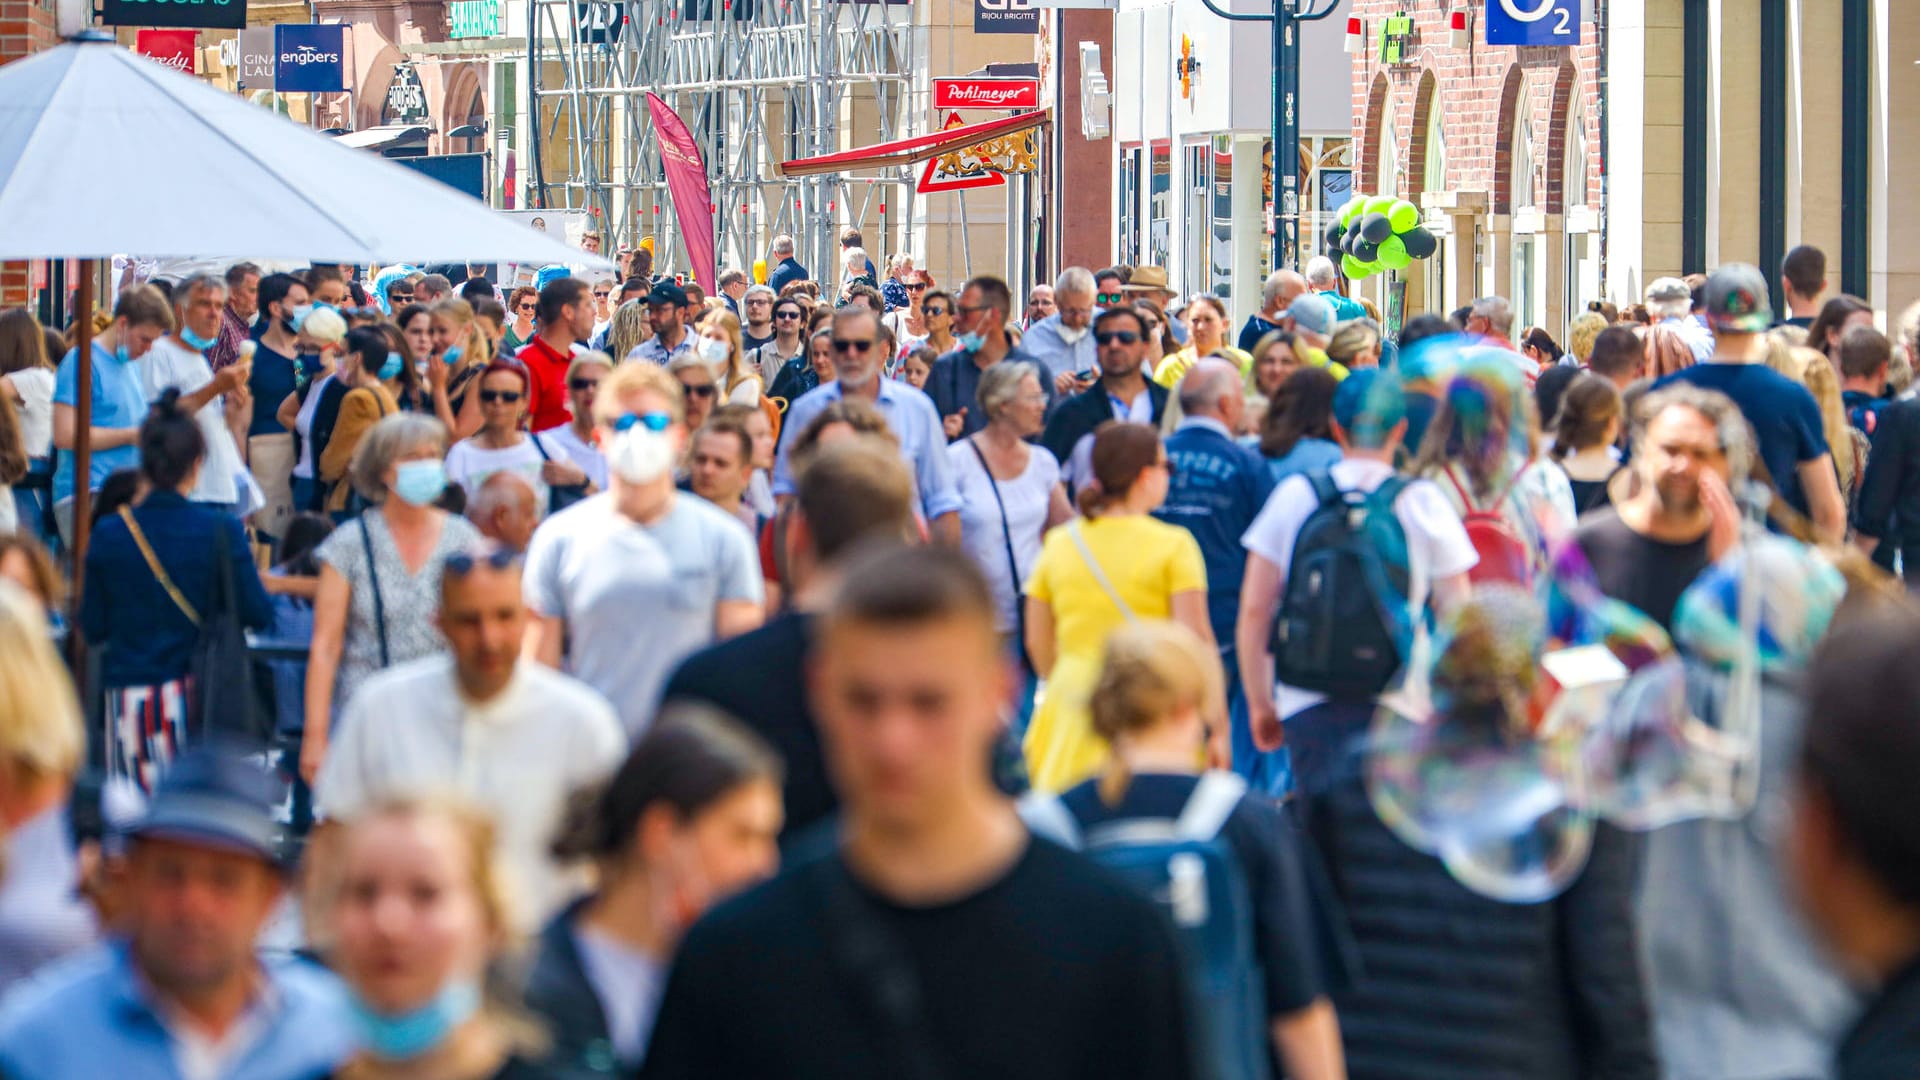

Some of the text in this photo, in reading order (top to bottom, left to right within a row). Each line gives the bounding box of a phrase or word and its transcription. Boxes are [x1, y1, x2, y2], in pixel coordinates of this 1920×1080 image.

[981, 12, 1036, 20] BIJOU BRIGITTE
[280, 50, 338, 65] engbers
[947, 84, 1030, 104] Pohlmeyer
